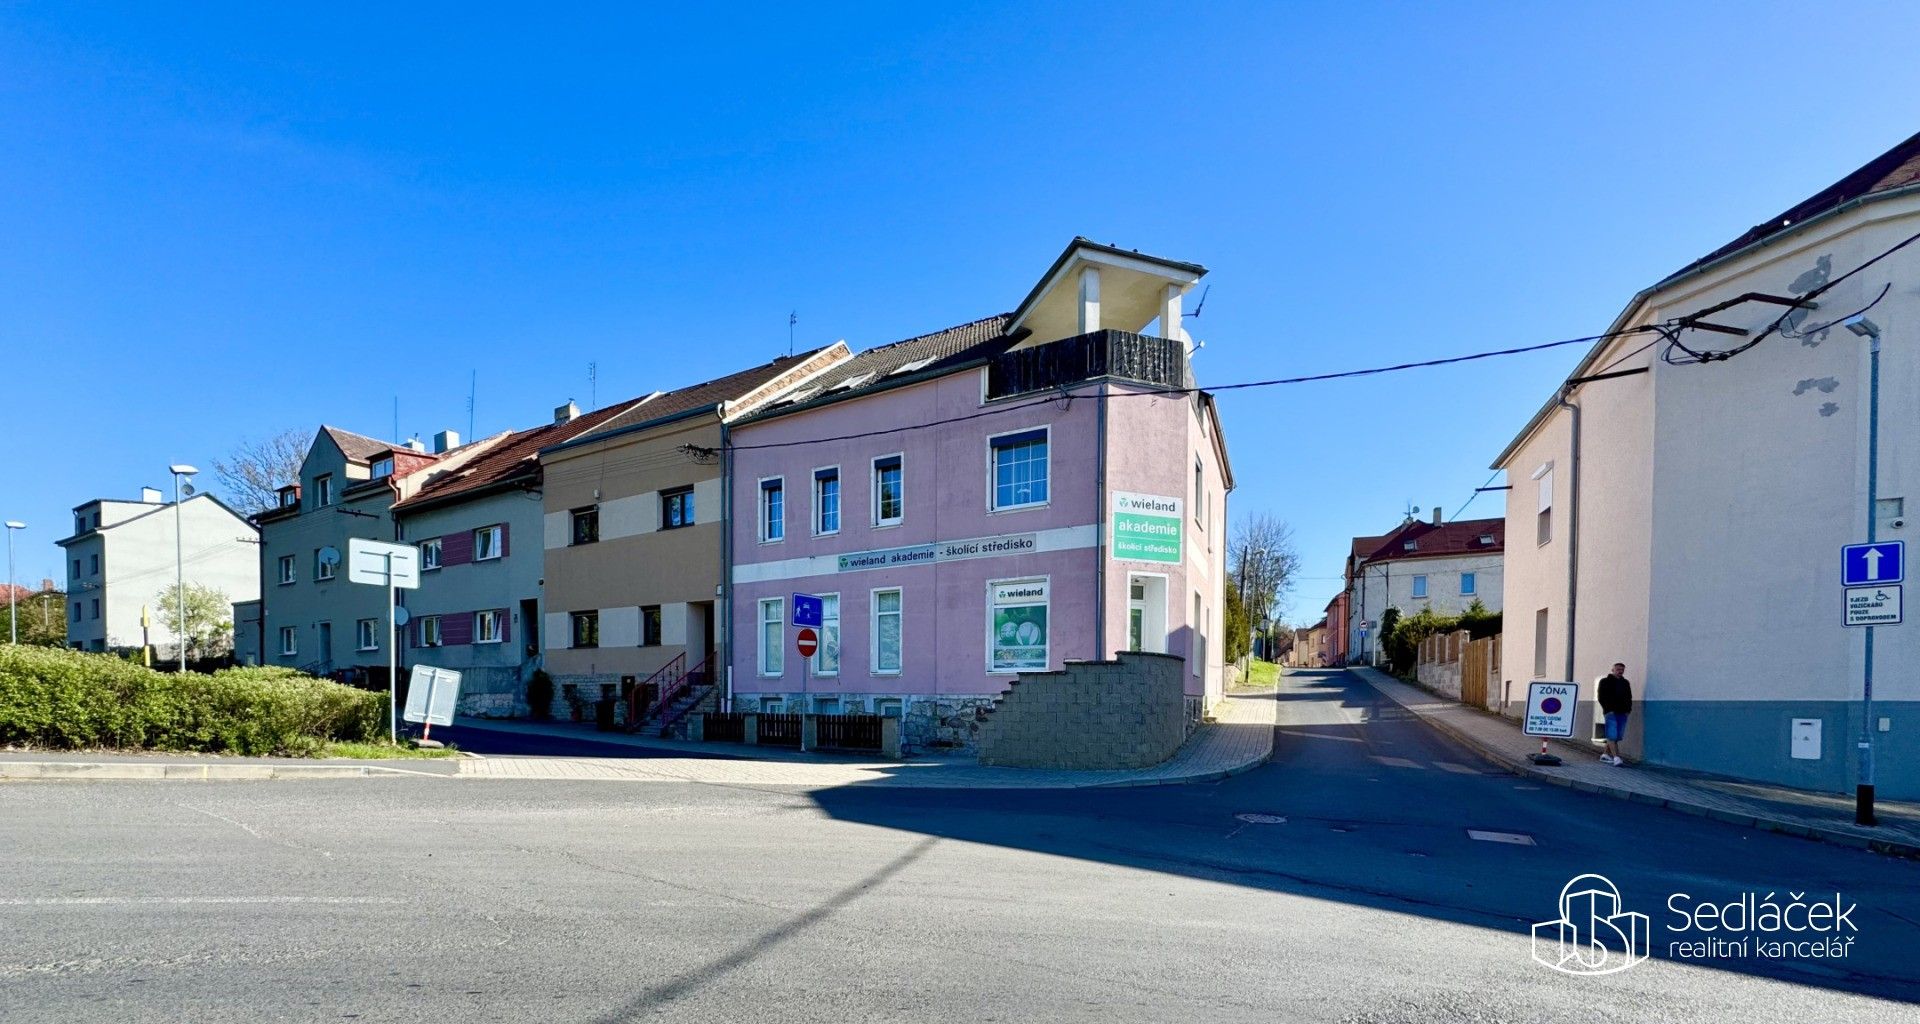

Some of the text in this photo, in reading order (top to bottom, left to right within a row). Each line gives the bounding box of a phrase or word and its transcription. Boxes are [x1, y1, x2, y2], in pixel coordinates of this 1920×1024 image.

[1131, 498, 1176, 512] wieland
[1119, 519, 1177, 536] akademie
[850, 554, 886, 567] wieland
[891, 549, 935, 562] akademie
[982, 538, 1033, 552] středisko
[1007, 587, 1043, 598] wieland
[1539, 686, 1568, 696] ZÓNA
